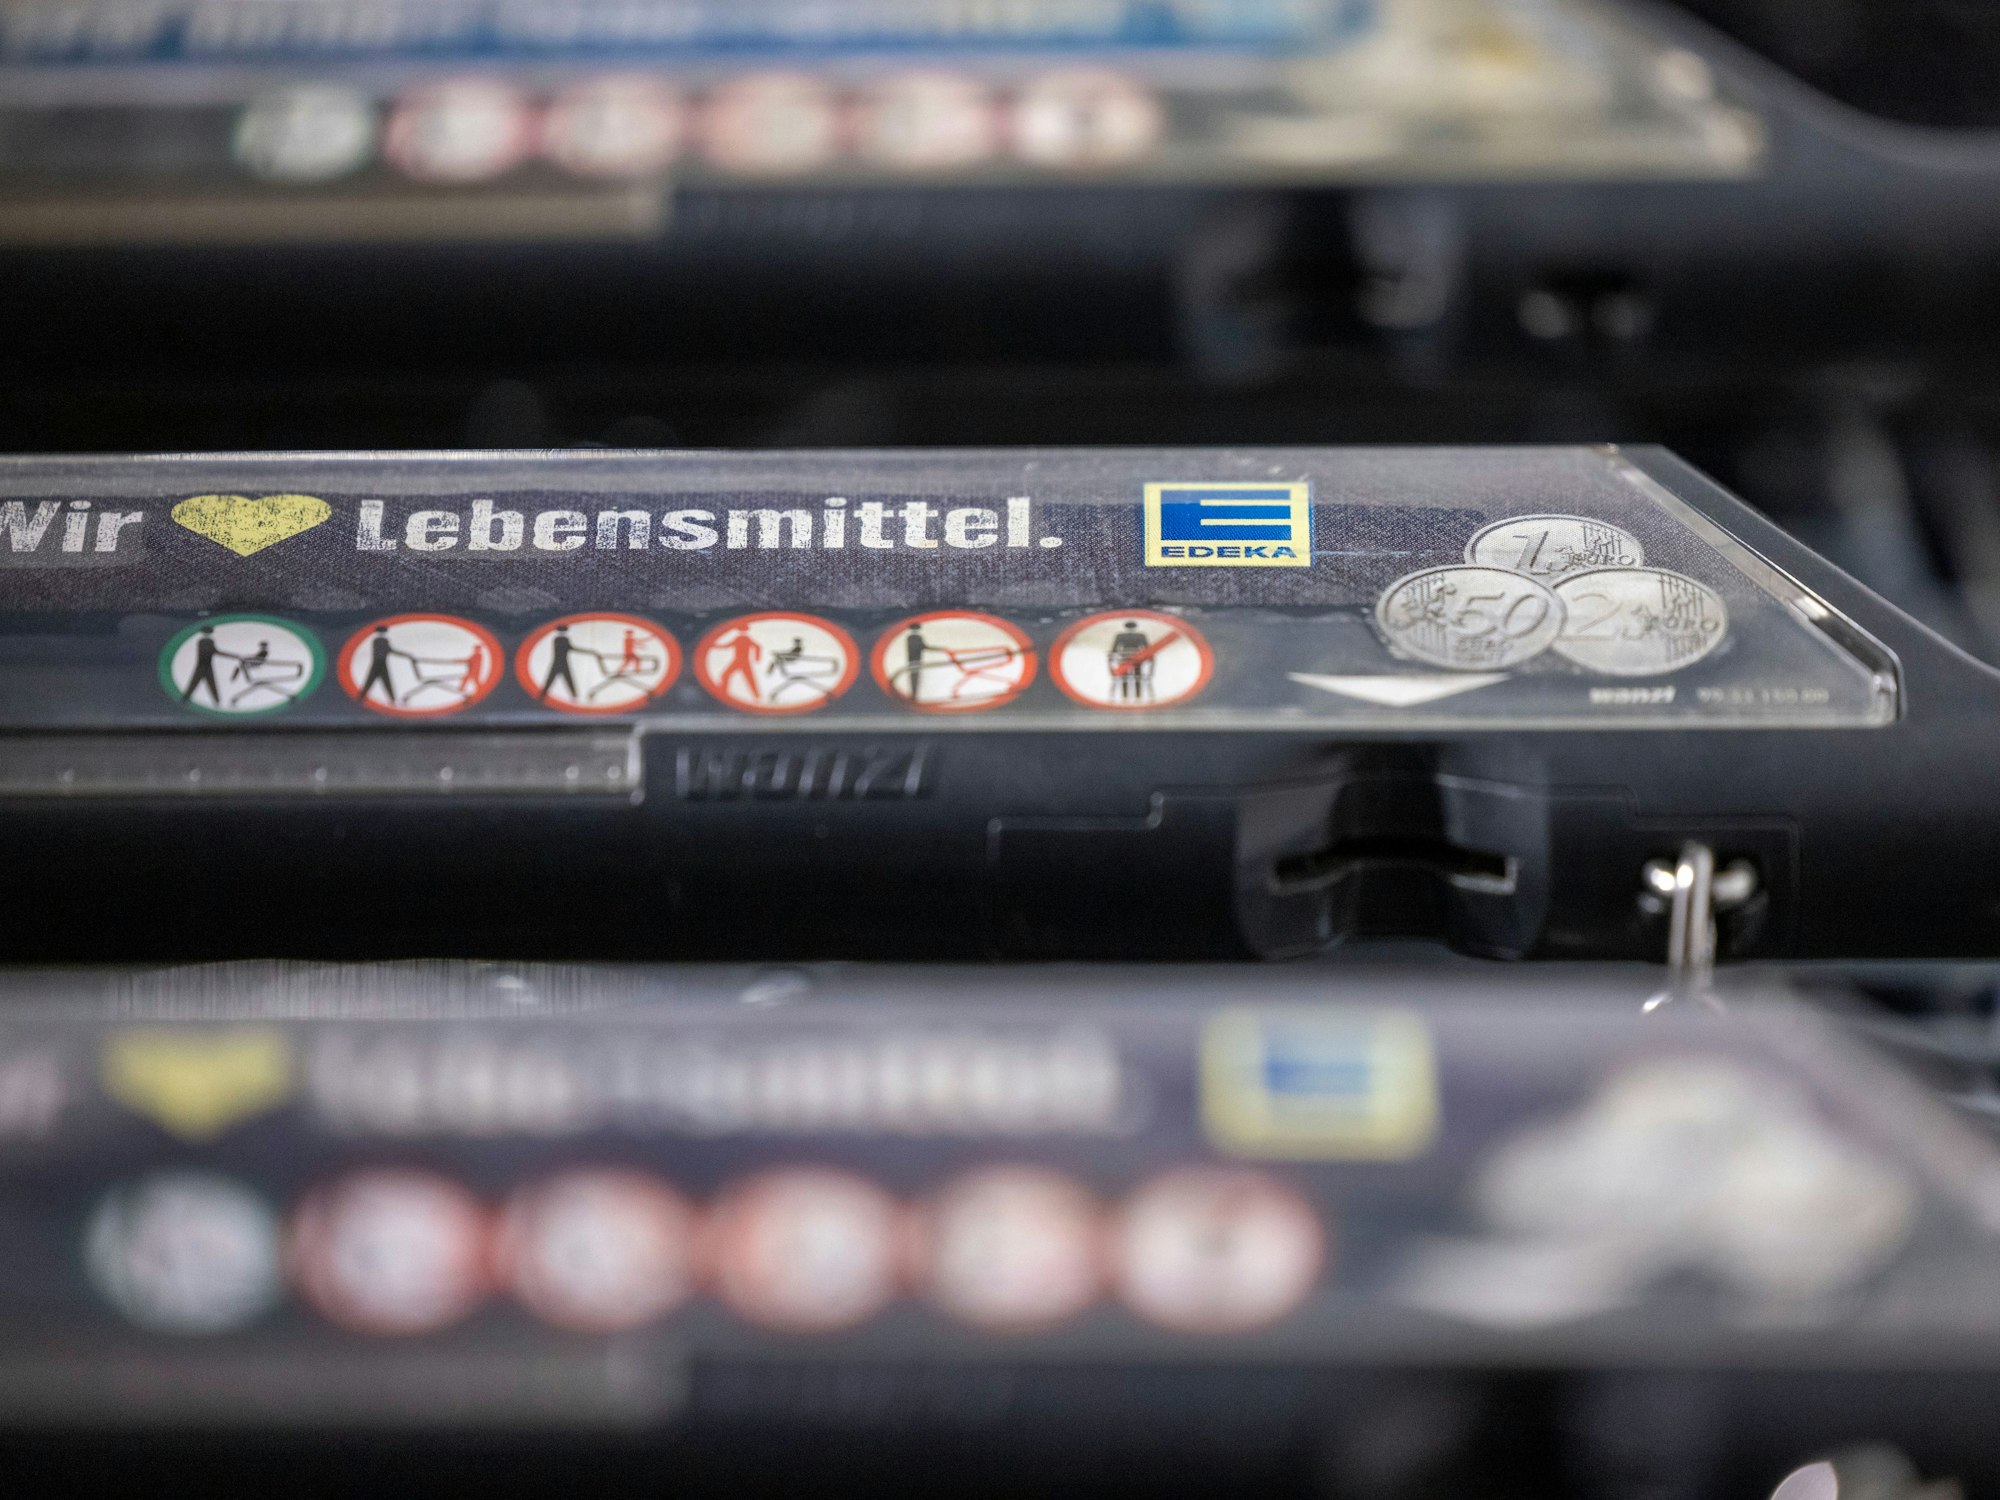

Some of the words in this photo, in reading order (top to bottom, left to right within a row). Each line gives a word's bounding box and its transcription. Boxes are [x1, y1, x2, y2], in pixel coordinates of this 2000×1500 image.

[356, 496, 1063, 552] Lebensmittel.
[1160, 545, 1298, 559] EDEKA
[1451, 592, 1550, 640] 50
[1557, 592, 1624, 642] 2
